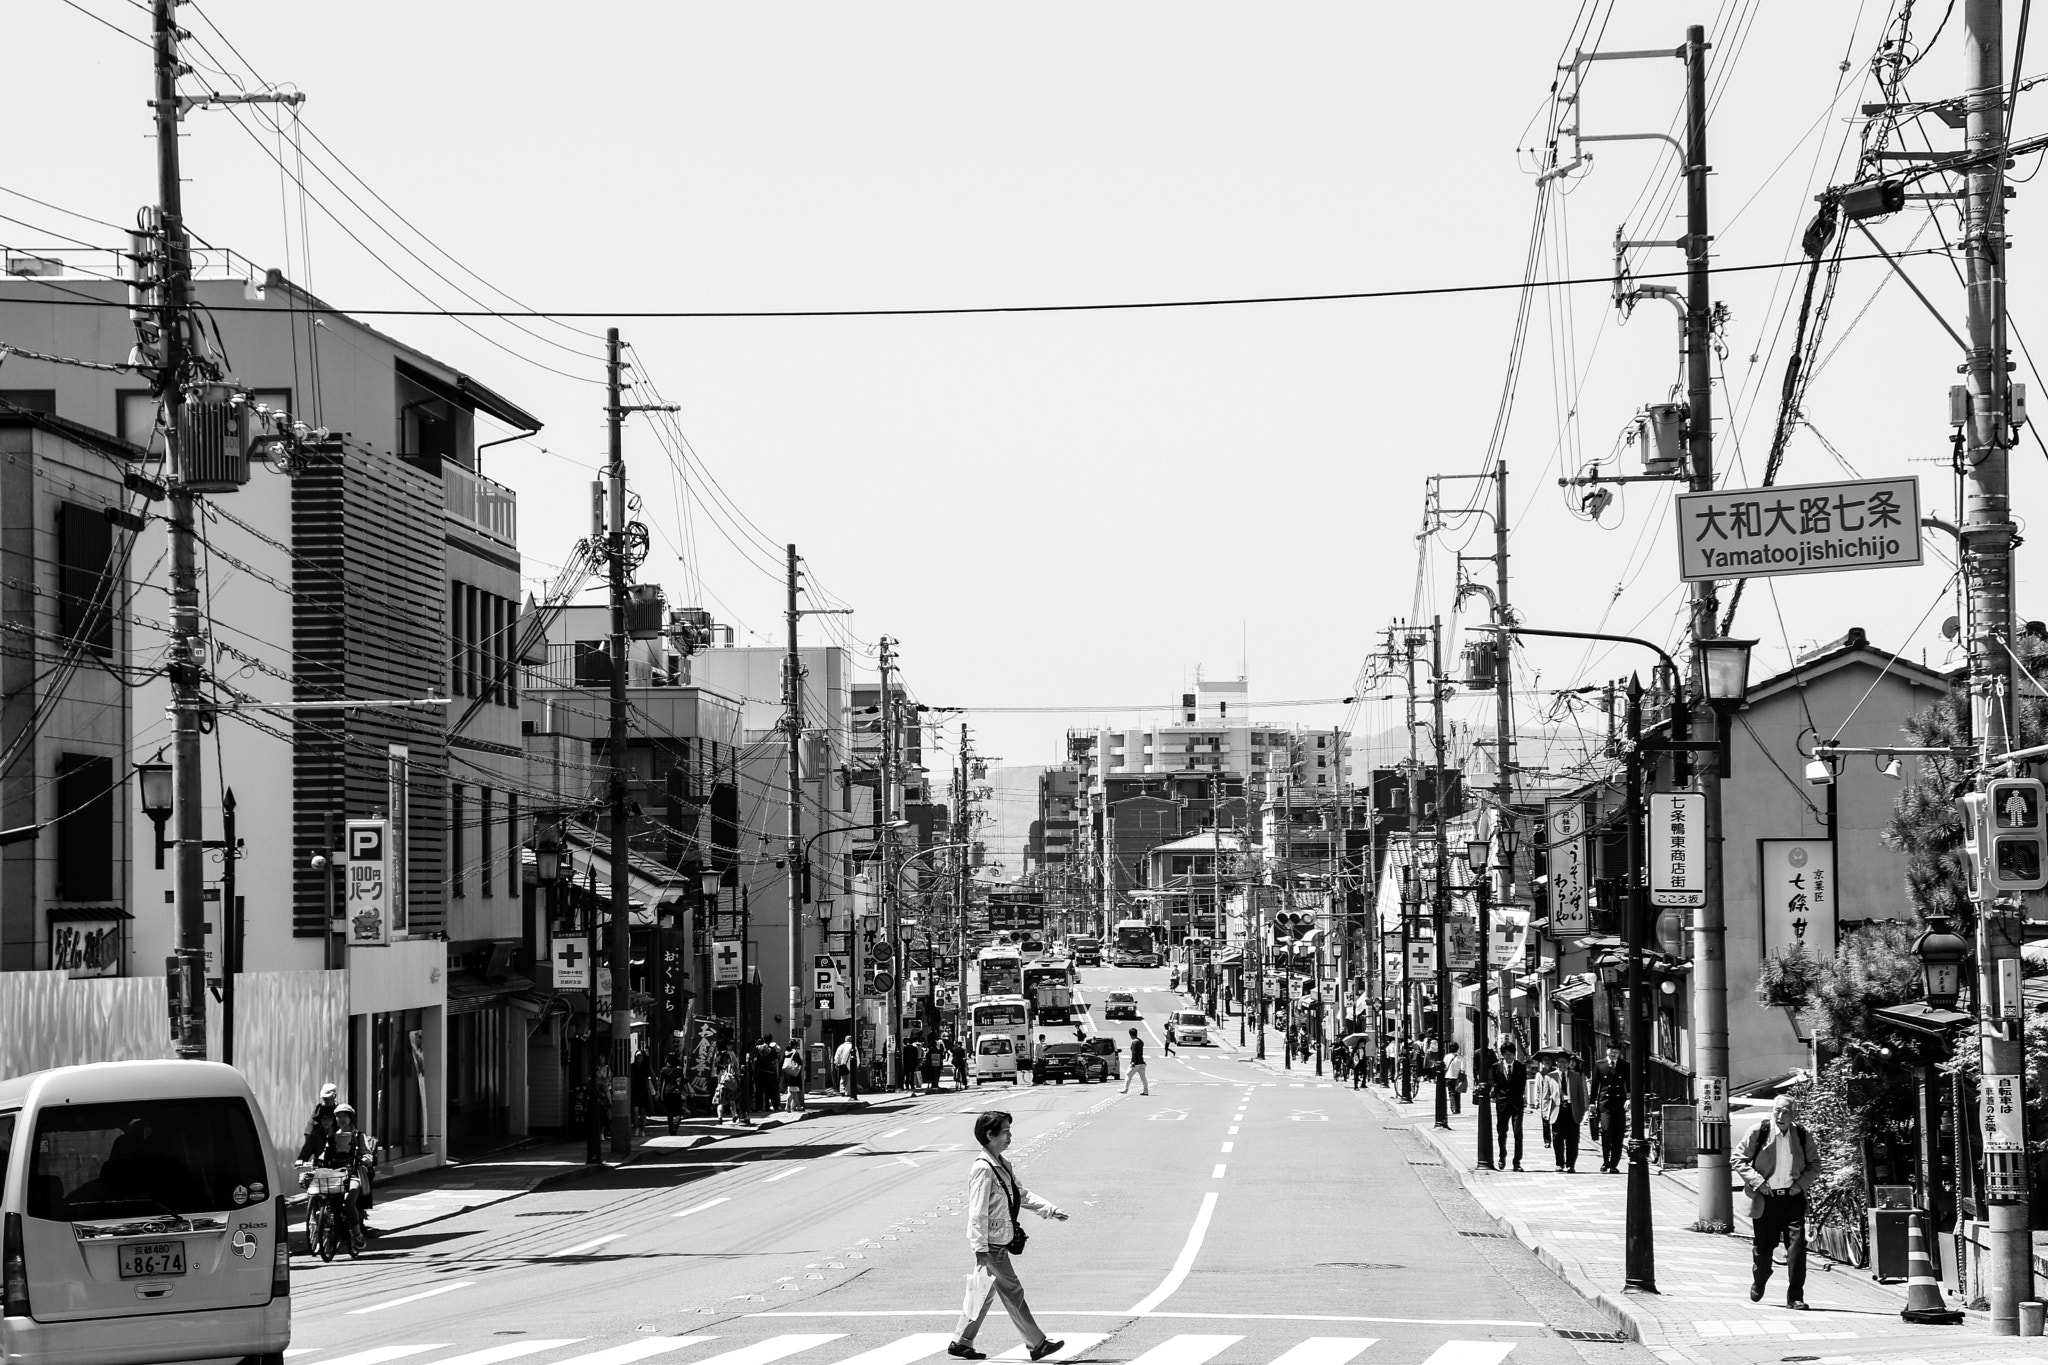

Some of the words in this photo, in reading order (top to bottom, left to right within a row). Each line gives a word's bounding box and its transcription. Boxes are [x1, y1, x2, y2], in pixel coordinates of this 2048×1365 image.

[1696, 491, 1902, 542] 大和大路七条
[1701, 536, 1901, 568] Yamatoojishichijo
[353, 831, 379, 857] P
[1670, 796, 1686, 888] 七条鴨東商店街
[350, 866, 381, 881] 100円
[1813, 868, 1825, 903] 京菓匠
[349, 881, 383, 901] パーク
[1658, 894, 1699, 904] こころ坂
[1788, 872, 1810, 948] 七條甘
[664, 950, 676, 1011] おくむら
[817, 972, 831, 989] P
[1999, 1078, 2014, 1114] 自転車は
[134, 1254, 182, 1274] 86-74
